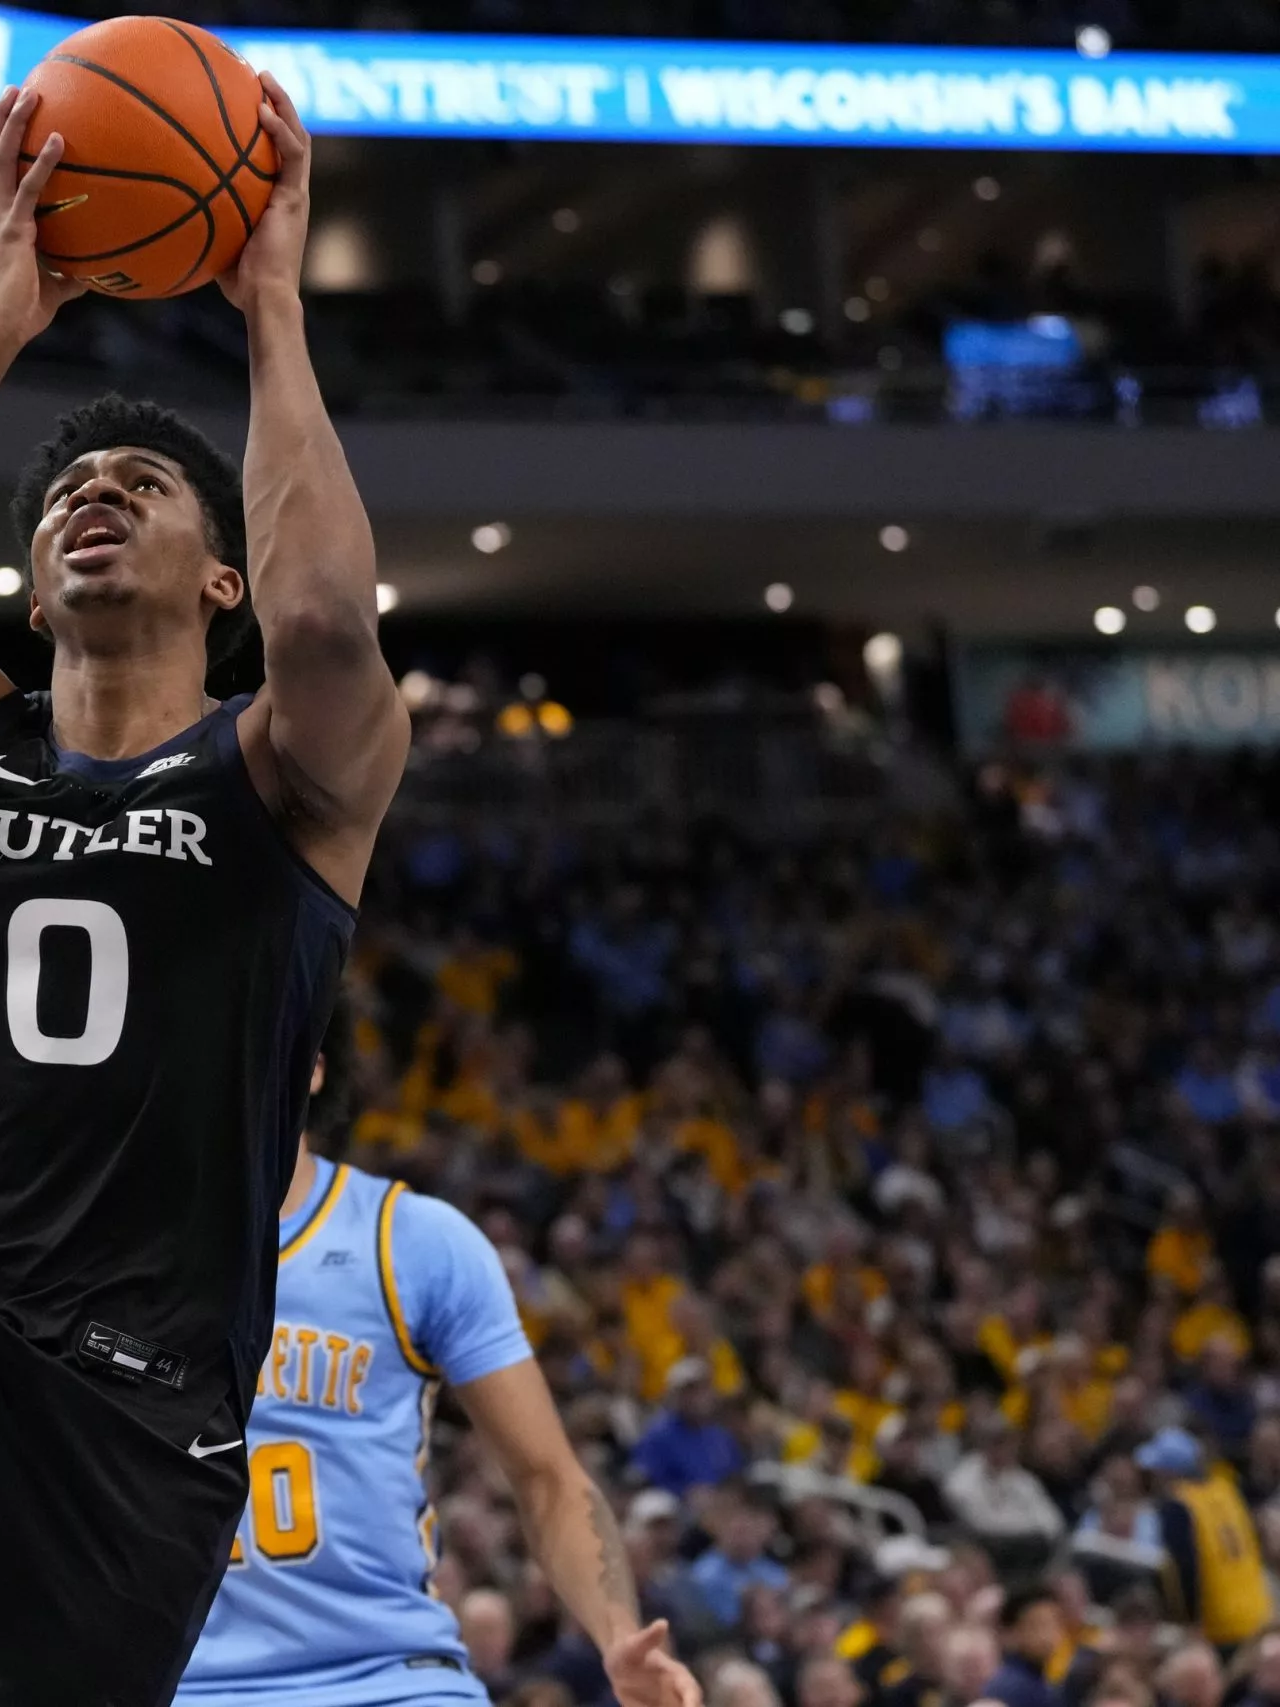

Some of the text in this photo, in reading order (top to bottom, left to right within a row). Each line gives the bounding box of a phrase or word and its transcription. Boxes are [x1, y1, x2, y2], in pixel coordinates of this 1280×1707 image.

[660, 67, 1060, 135] WISCONSIN'S
[1069, 77, 1240, 138] BANK
[6, 897, 129, 1066] 0
[155, 1358, 174, 1373] 44
